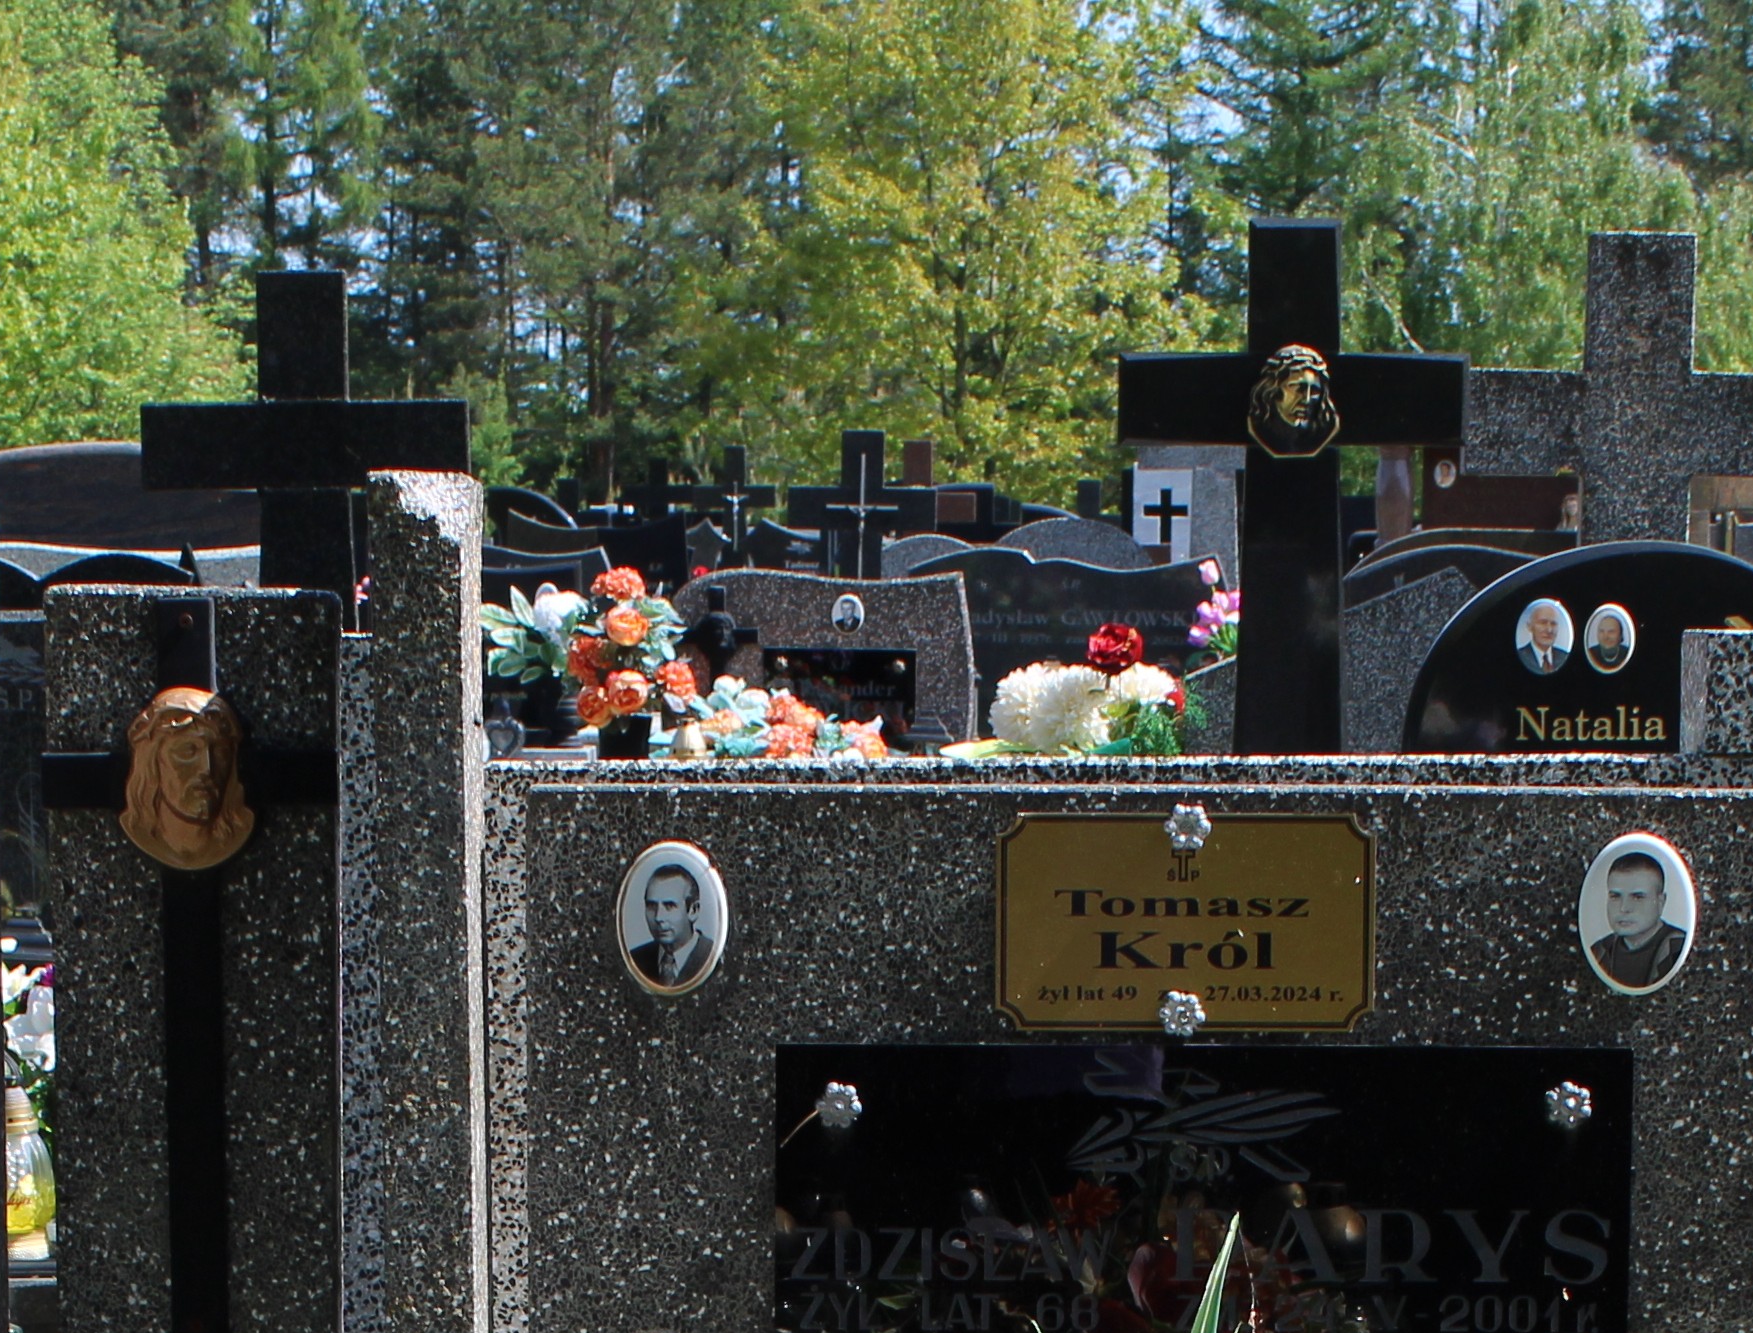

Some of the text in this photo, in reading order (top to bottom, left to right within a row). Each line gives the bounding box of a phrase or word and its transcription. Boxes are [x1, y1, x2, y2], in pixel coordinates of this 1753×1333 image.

[1515, 705, 1667, 741] Natalia
[1054, 888, 1310, 918] Tomasz
[1094, 929, 1276, 970] Król
[1037, 984, 1070, 1001] żył
[1077, 984, 1104, 1001] lat
[1113, 985, 1138, 1001] 49
[1205, 985, 1321, 1002] 27.03.2024
[1329, 990, 1344, 1002] r.
[790, 1226, 1114, 1281] ZDZISŁAW
[920, 1293, 1000, 1331] LAT
[1035, 1292, 1100, 1332] 68
